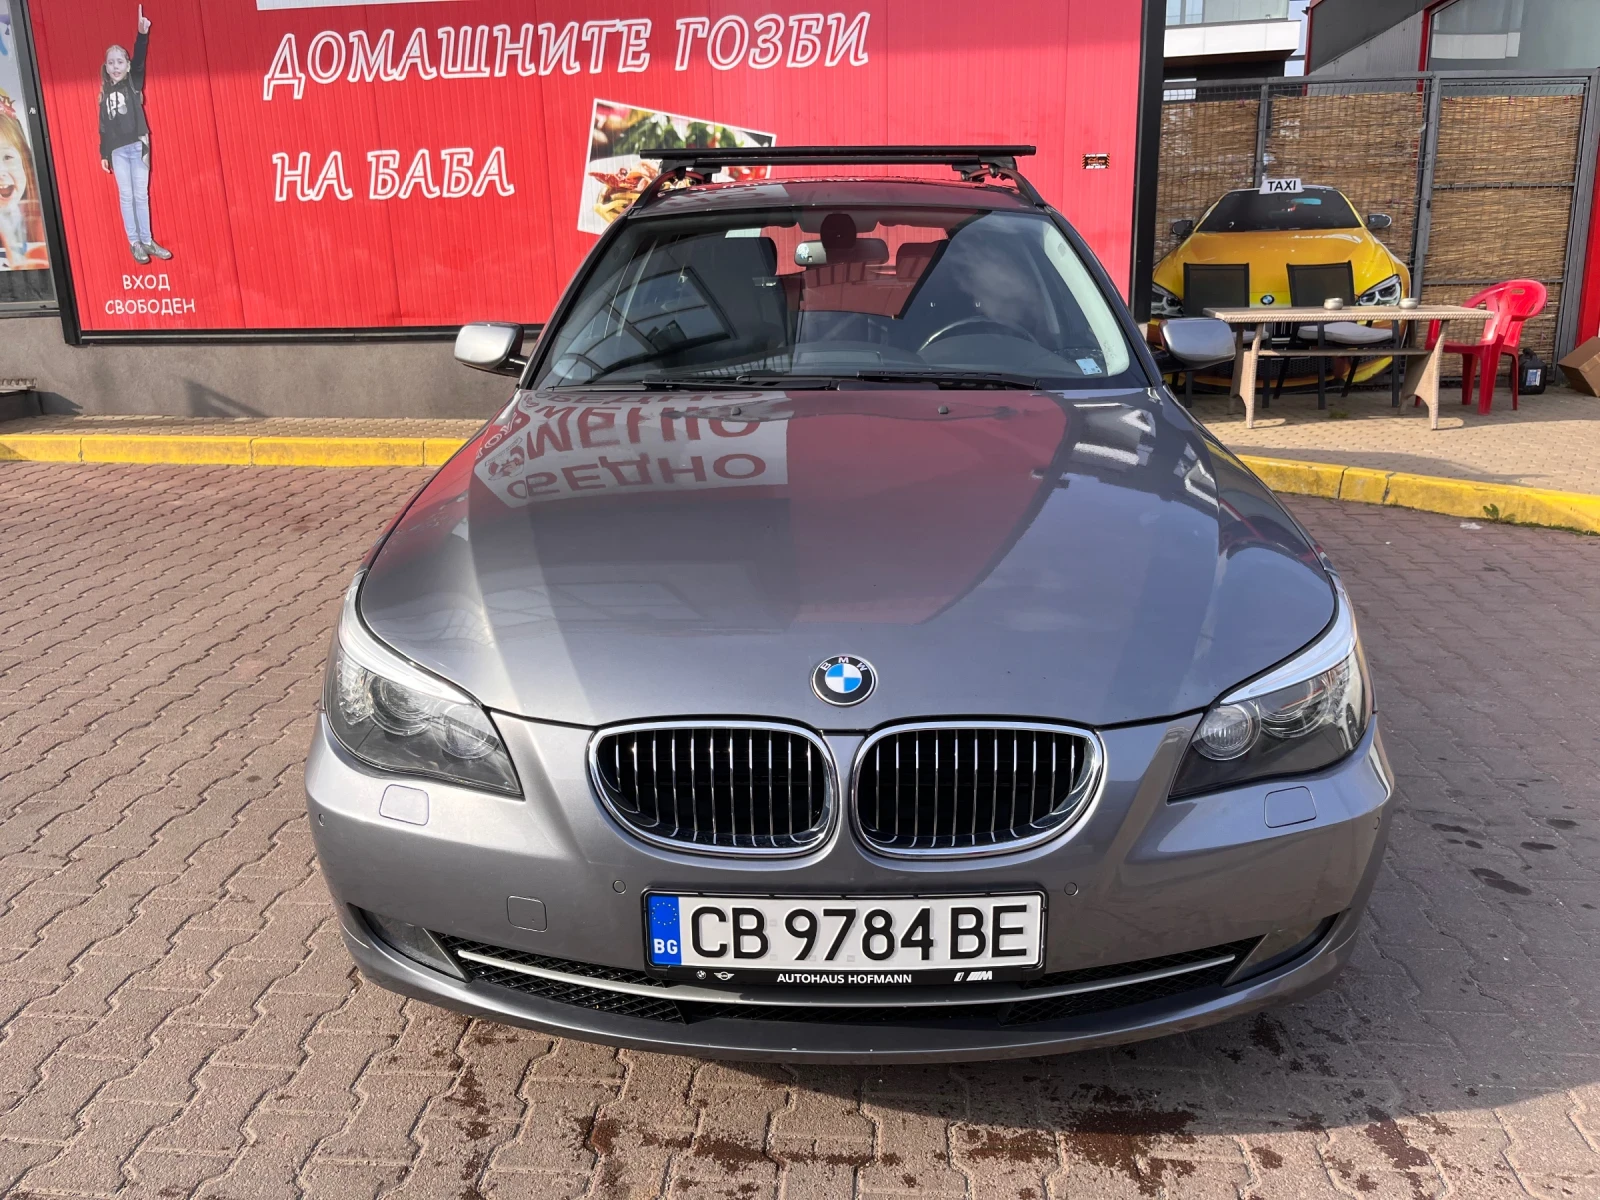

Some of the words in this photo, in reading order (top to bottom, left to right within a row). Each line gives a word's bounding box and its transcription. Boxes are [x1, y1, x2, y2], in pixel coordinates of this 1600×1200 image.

[263, 17, 652, 101] ДОМАШНИТЕ
[675, 12, 870, 72] ГОЗБИ
[273, 150, 353, 202] НА
[368, 146, 515, 200] БАБА
[1267, 180, 1297, 191] TAXI
[122, 273, 170, 291] ВХОД
[105, 298, 195, 316] СВОБОДЕН
[690, 906, 769, 959] CB
[785, 907, 934, 961] 9784
[949, 904, 1028, 960] BE
[653, 938, 678, 955] BG
[776, 973, 845, 984] AUTOHAUS
[847, 974, 912, 984] HOFMANN
